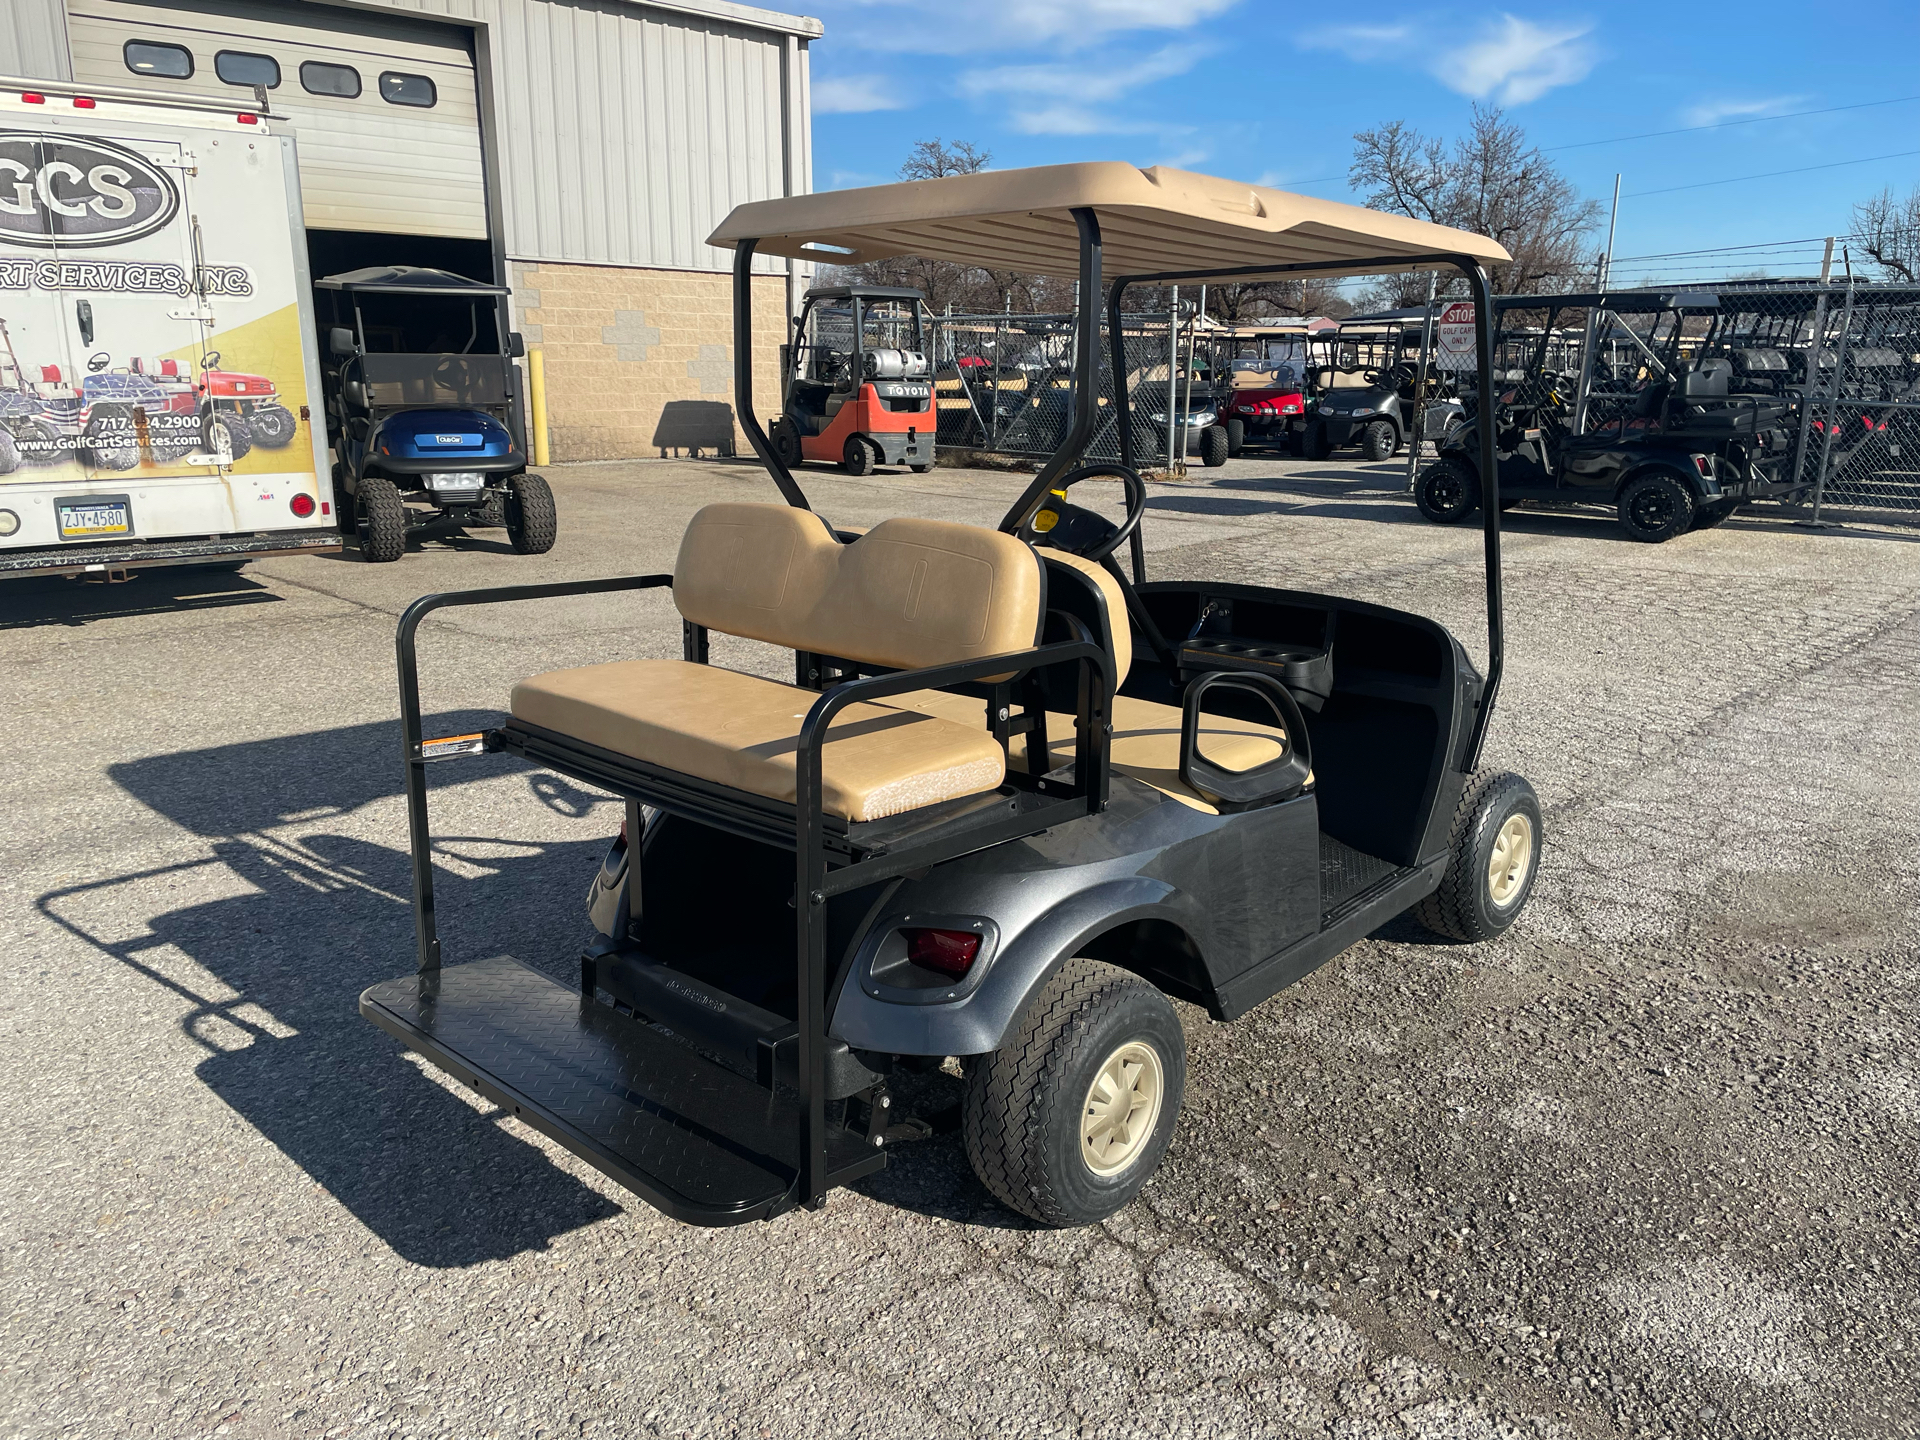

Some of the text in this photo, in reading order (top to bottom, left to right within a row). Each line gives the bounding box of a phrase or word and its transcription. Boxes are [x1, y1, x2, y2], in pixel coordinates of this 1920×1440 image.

[0, 157, 137, 219] GCS
[36, 260, 190, 296] SERVICES,
[1448, 309, 1476, 322] STOP
[1442, 327, 1477, 335] GOLF CART
[1451, 337, 1468, 345] ONLY
[887, 386, 929, 396] TOYOTA
[14, 434, 202, 451] www.GolfCartServices.com
